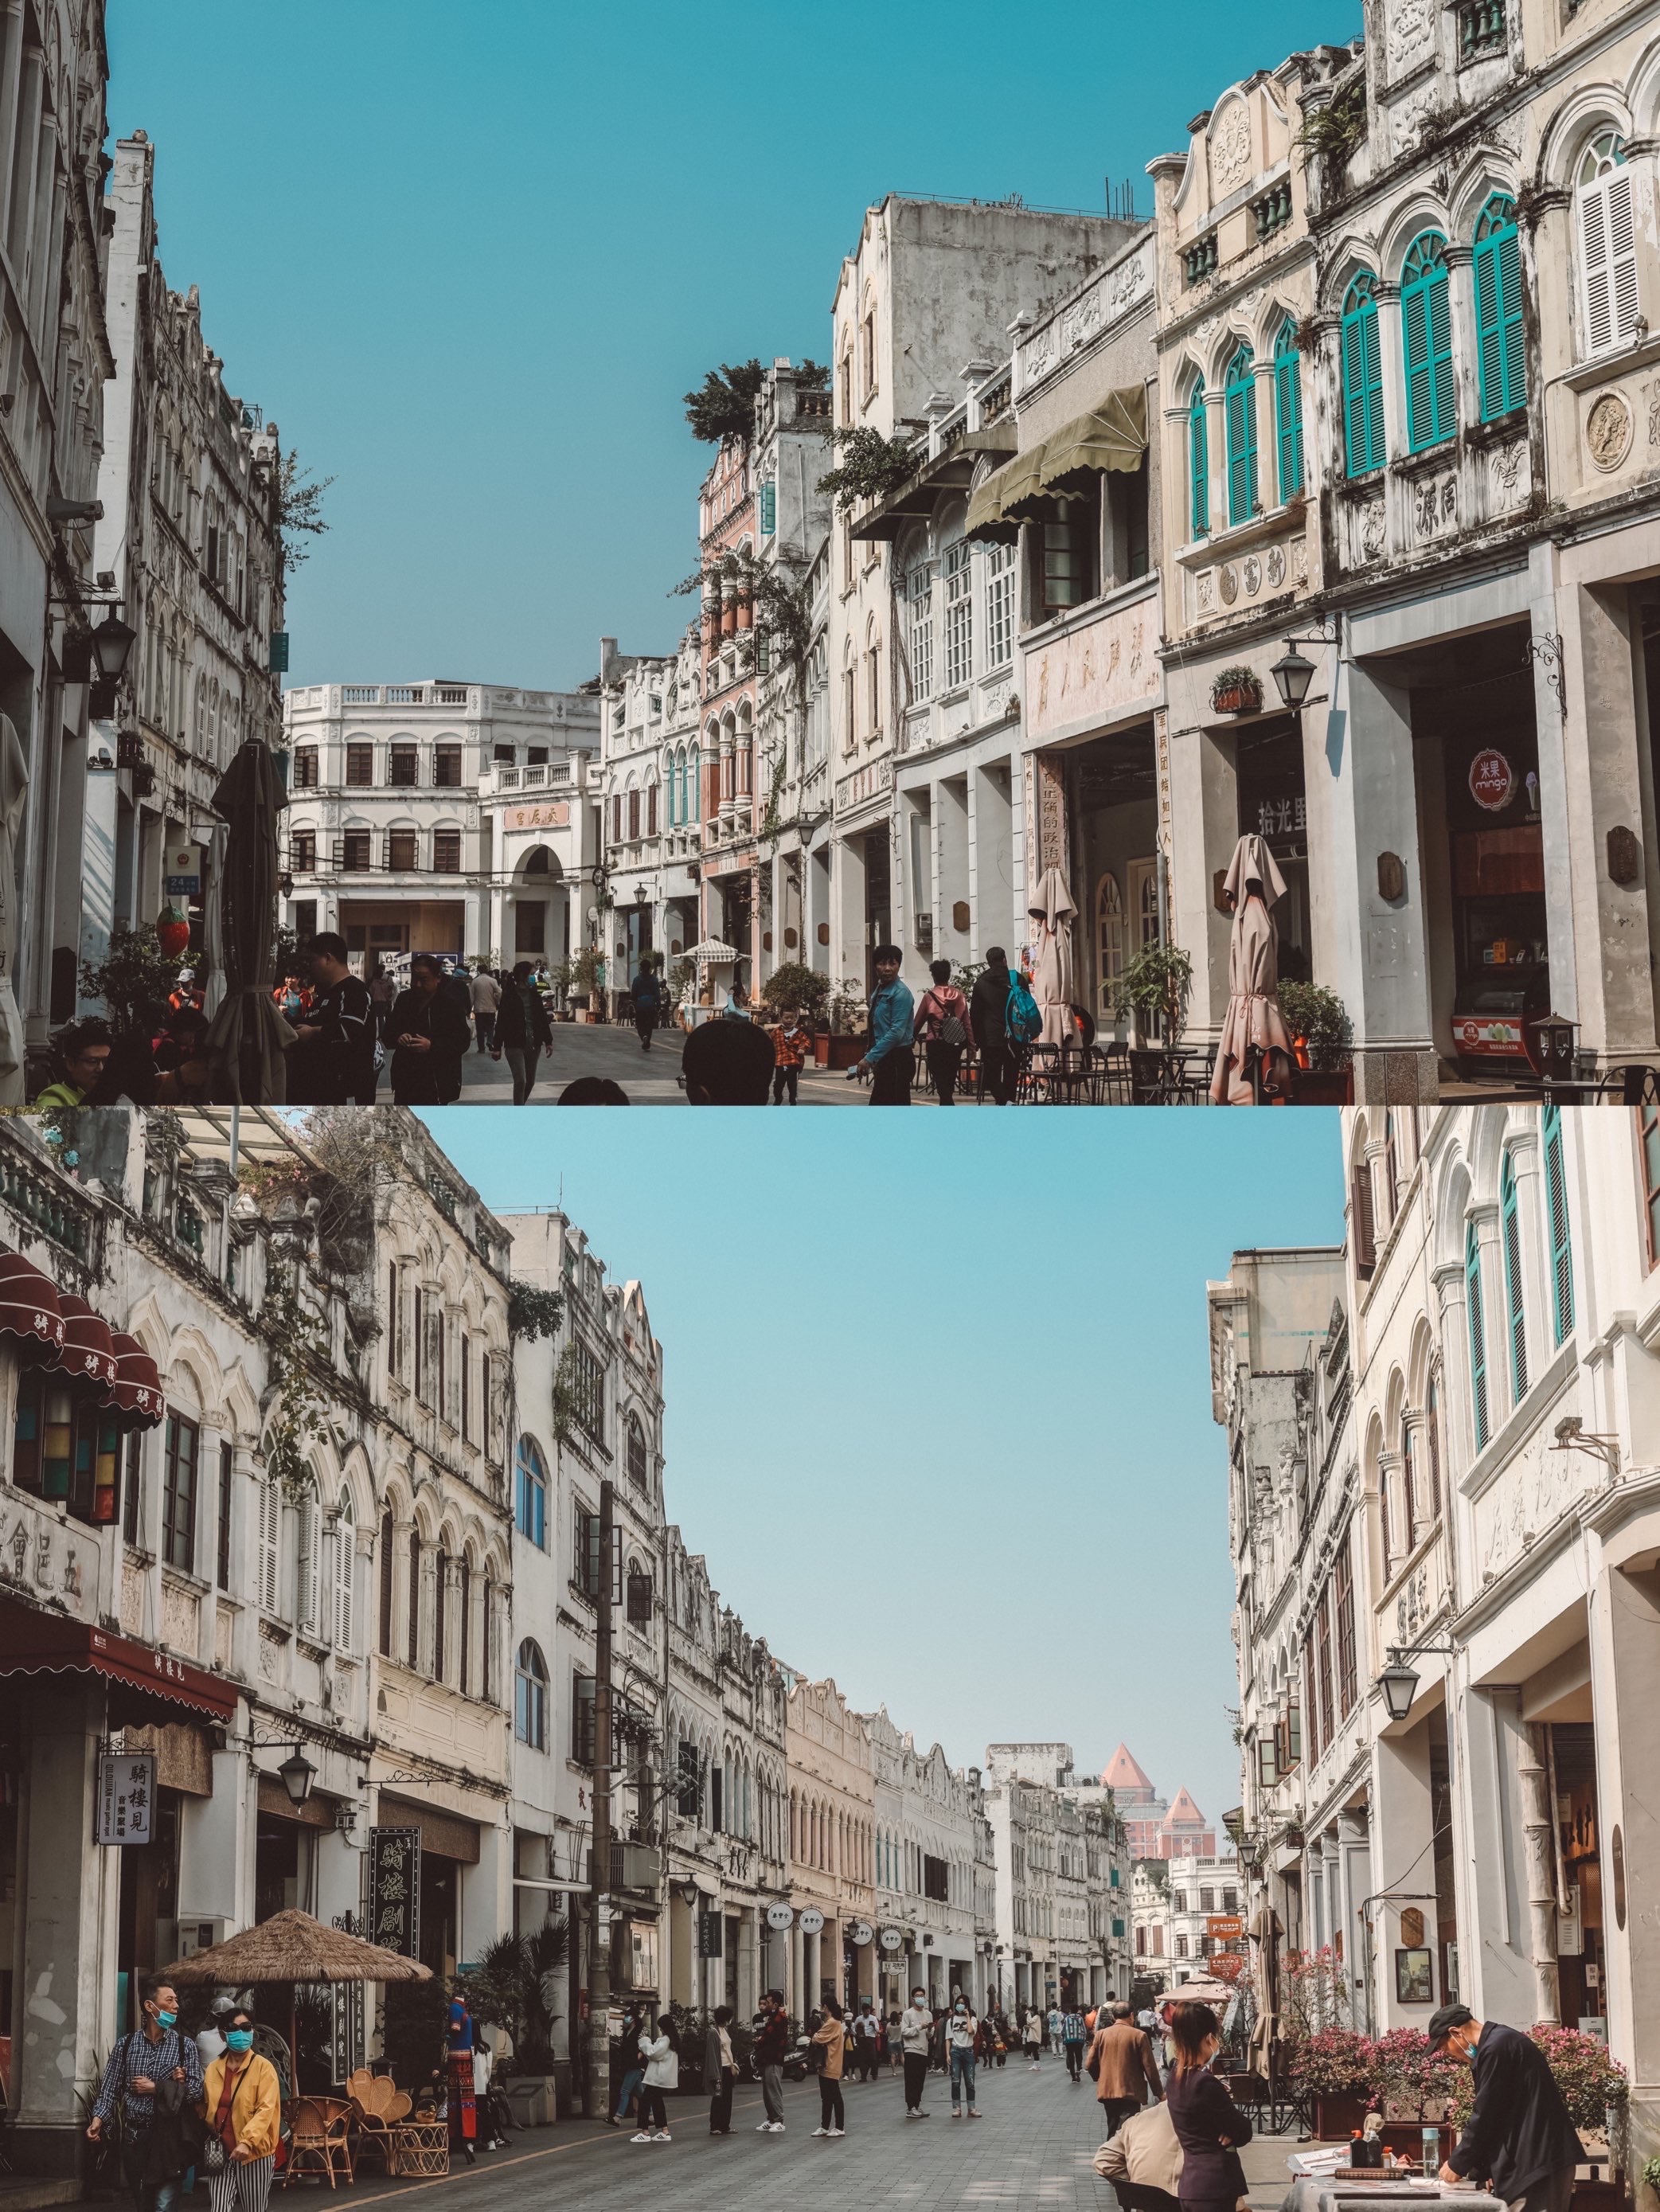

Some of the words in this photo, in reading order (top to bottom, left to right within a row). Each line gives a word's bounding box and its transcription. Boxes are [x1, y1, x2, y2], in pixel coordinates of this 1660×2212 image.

[1475, 778, 1507, 791] mingo
[0, 1518, 82, 1599] 五邑會
